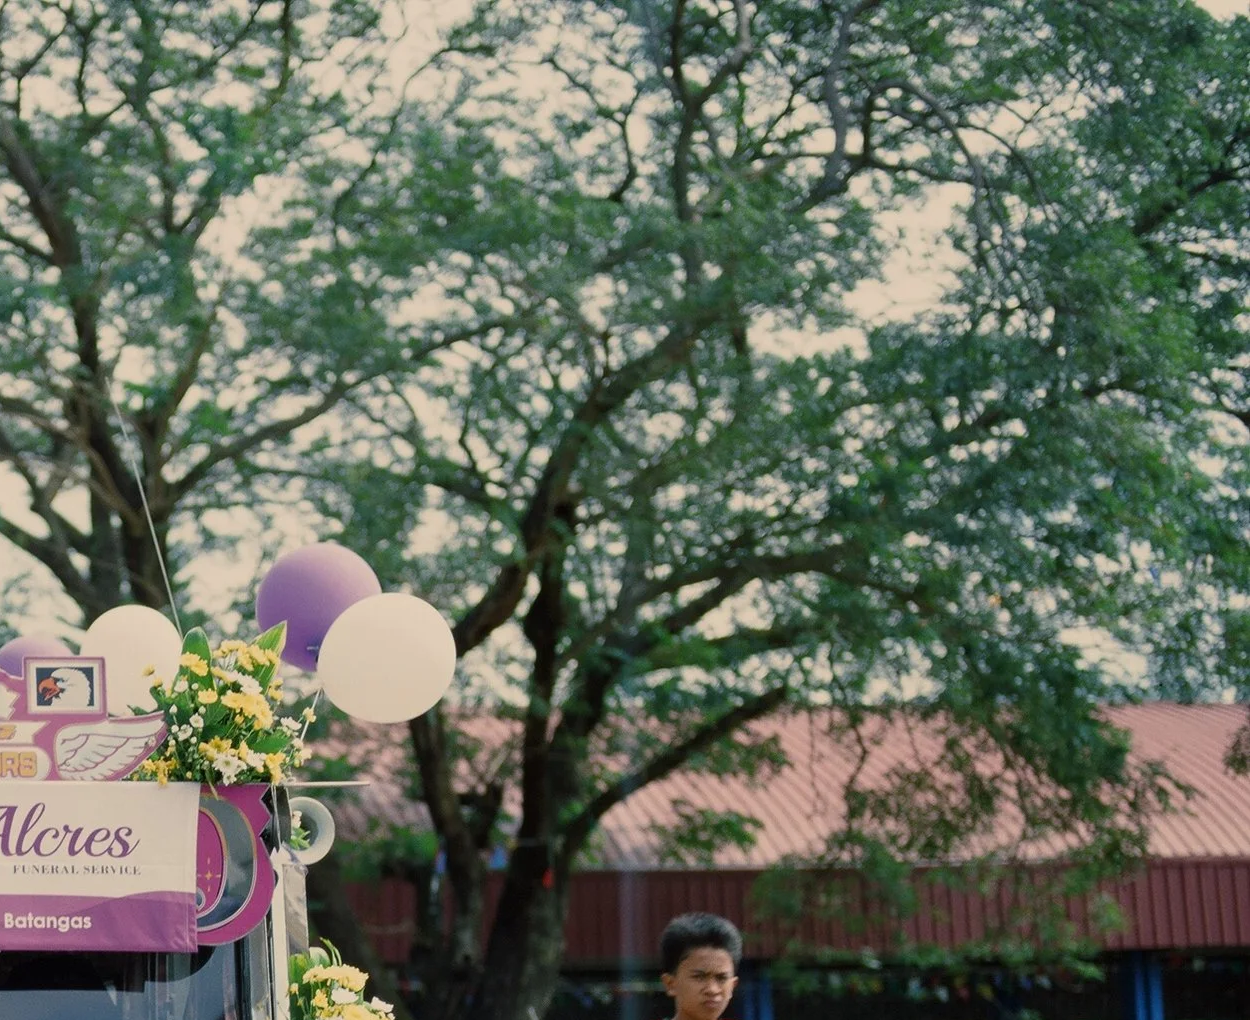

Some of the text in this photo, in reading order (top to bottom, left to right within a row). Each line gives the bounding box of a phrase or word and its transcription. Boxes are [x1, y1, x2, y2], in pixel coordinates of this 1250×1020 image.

[13, 864, 142, 876] FUNERAL SERVICE
[4, 912, 92, 933] Batangas
